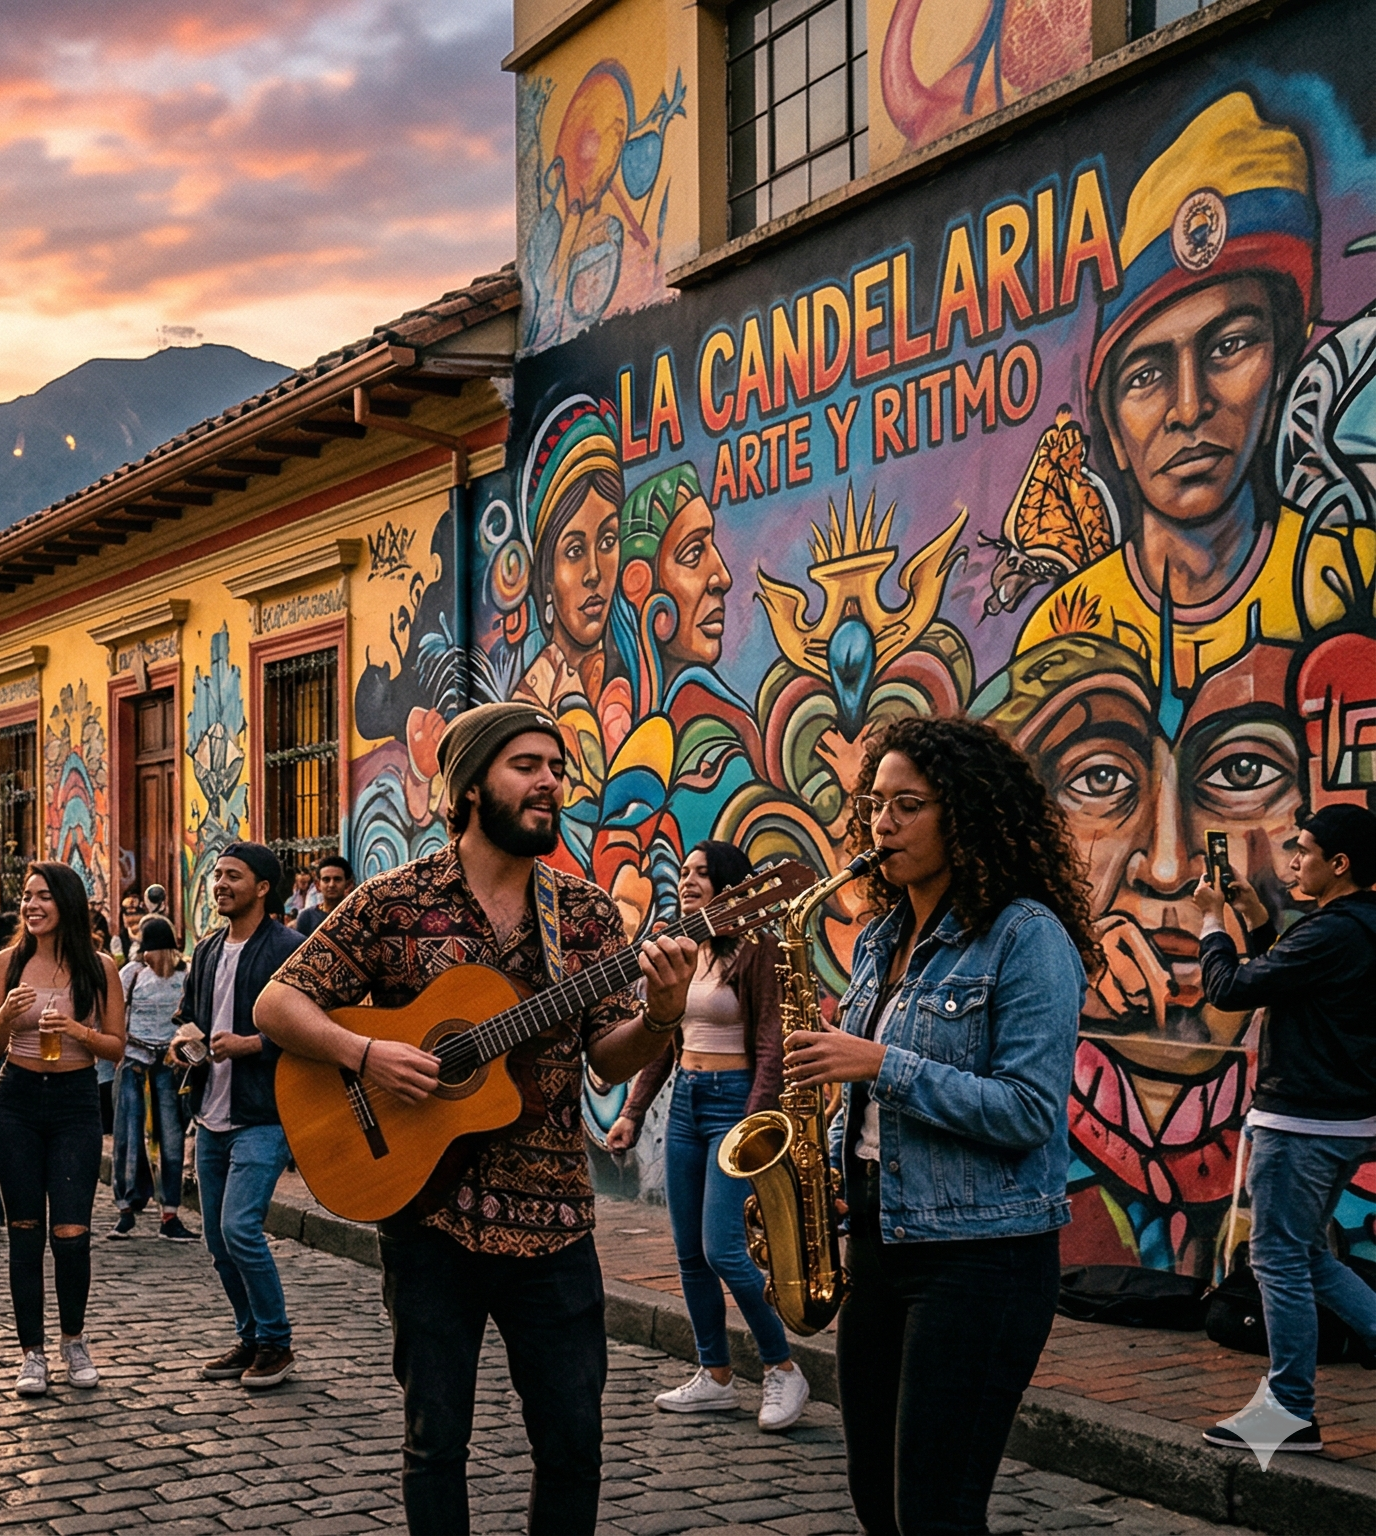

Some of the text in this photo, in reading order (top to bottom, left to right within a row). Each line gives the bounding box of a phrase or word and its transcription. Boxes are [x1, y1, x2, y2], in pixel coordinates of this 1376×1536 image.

[621, 170, 1119, 463] LA CANDELARIA
[712, 343, 1040, 506] ARTE Y RITMO
